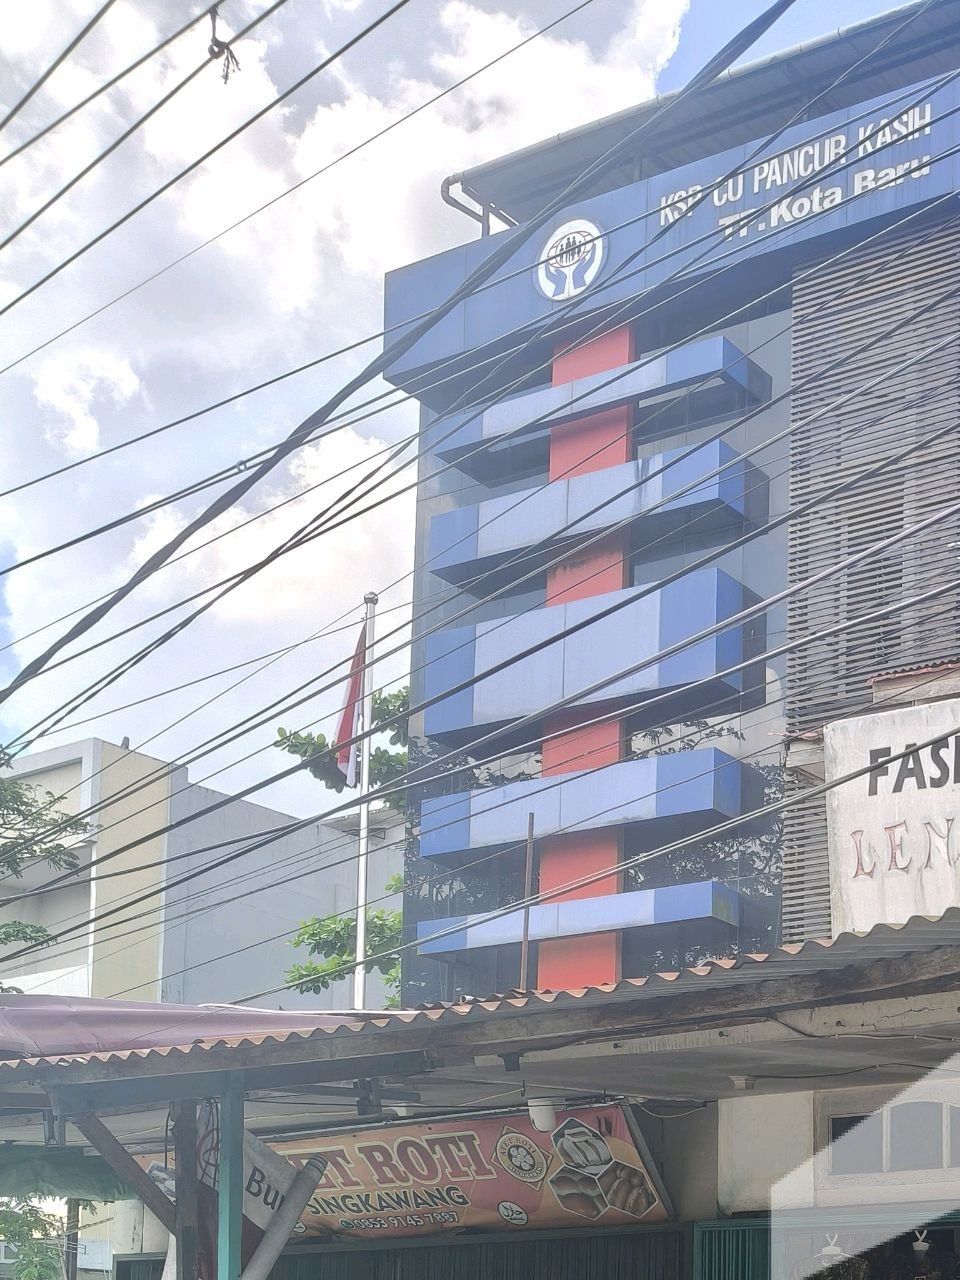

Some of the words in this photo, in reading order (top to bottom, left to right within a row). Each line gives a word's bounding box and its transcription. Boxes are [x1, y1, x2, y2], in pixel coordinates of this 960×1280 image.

[660, 184, 702, 226] KSP
[712, 171, 744, 206] CU
[754, 134, 846, 194] PANCUR
[858, 104, 931, 157] KASIH
[854, 155, 930, 195] Baru
[356, 1131, 497, 1187] ROTI
[307, 1185, 471, 1216] SINGKAWANG
[353, 1219, 389, 1229] 0853
